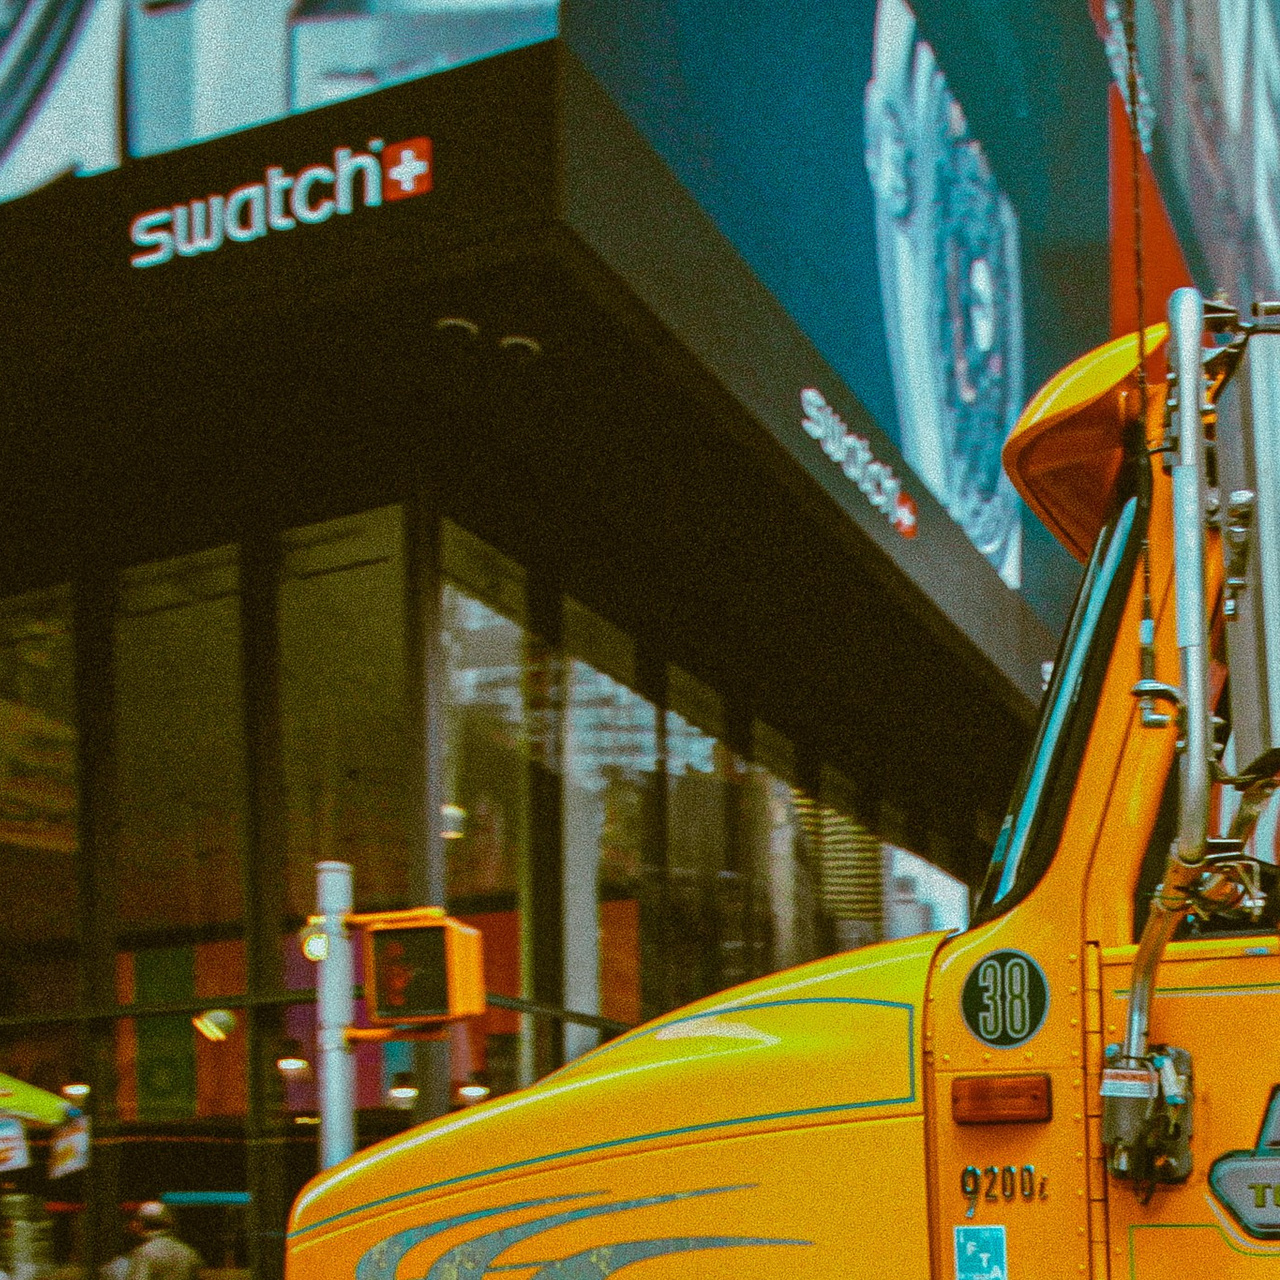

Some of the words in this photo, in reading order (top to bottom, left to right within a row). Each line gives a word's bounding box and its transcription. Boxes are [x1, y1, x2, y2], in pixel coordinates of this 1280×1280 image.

[129, 146, 384, 268] swatch
[978, 959, 1030, 1040] 38
[961, 1164, 1048, 1218] 9200i
